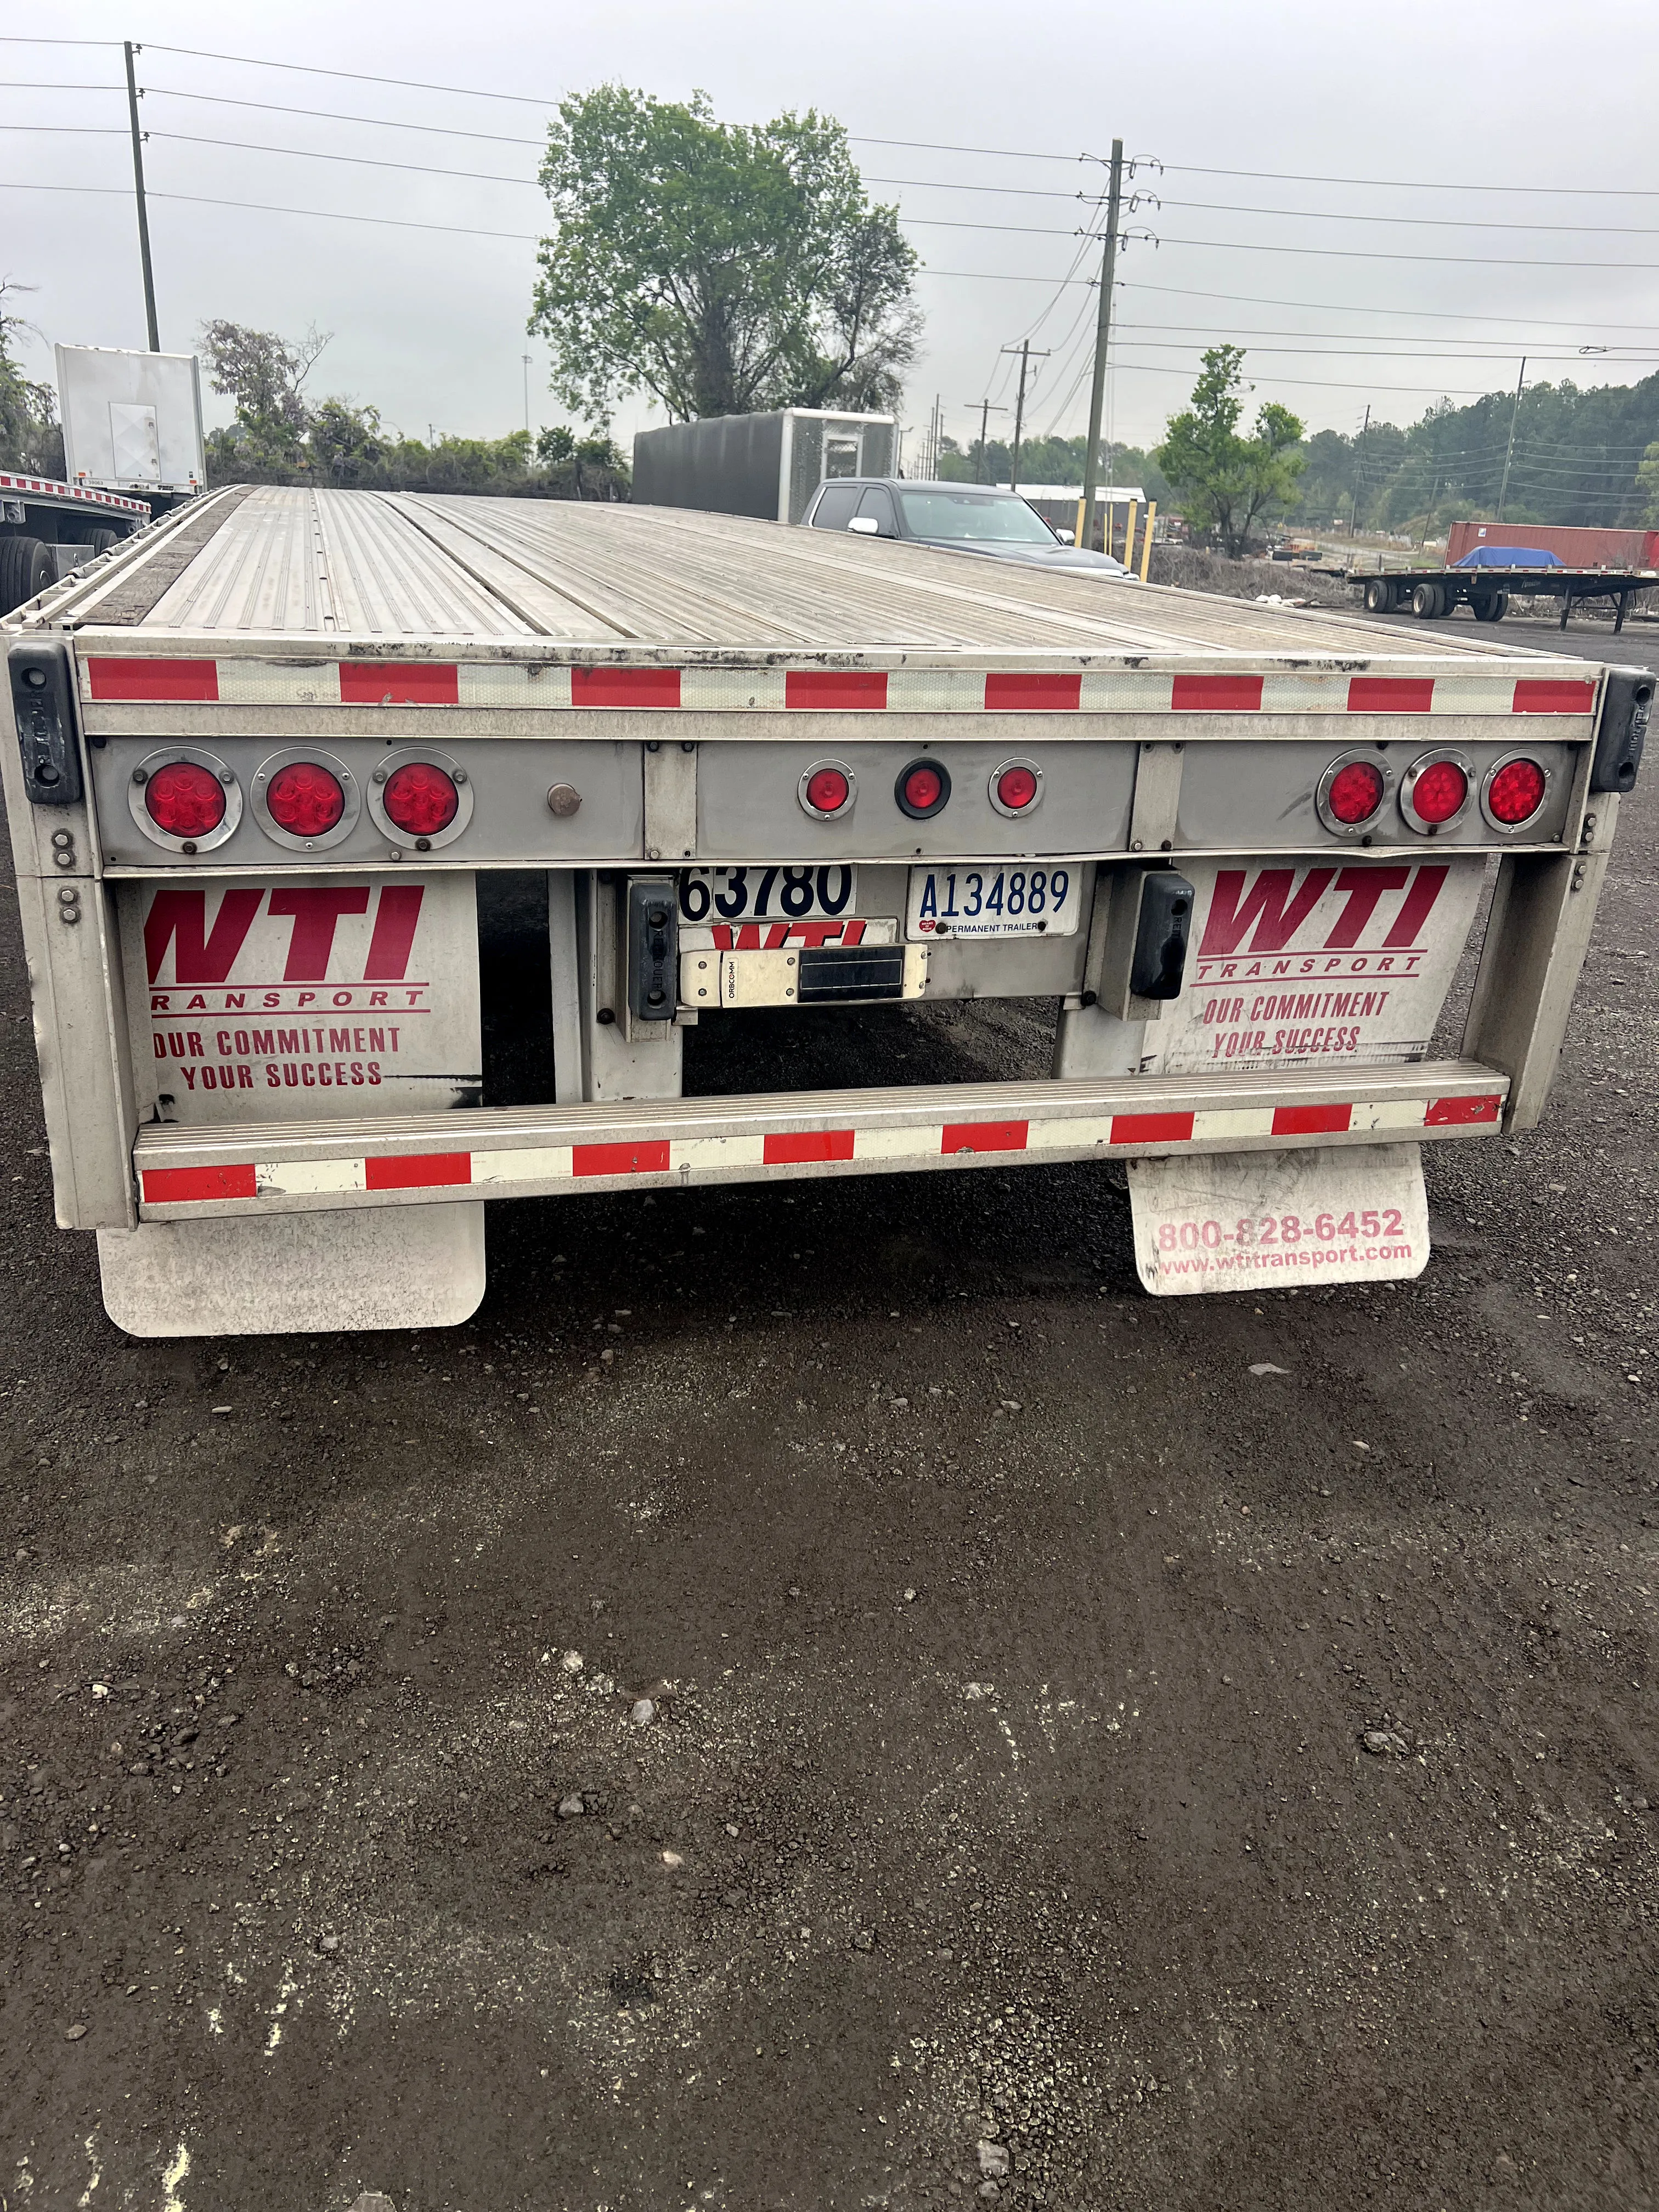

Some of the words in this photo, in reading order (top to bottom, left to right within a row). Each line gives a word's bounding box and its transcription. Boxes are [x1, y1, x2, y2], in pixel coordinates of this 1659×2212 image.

[679, 865, 852, 922] 63780
[919, 871, 1069, 918] A134889
[1198, 865, 1450, 956] WTI
[946, 924, 1000, 933] PERMANENT
[1003, 923, 1037, 932] TRAILER
[1198, 957, 1421, 980] TRANSPORT
[150, 990, 424, 1011] RANSPORT
[1203, 998, 1243, 1024] OUR
[1250, 991, 1390, 1022] COMMITMENT
[153, 1031, 205, 1059] OUR
[217, 1027, 400, 1056] COMMITMENT
[1211, 1030, 1266, 1058] YOUR
[1272, 1026, 1361, 1054] SUCCESS
[180, 1063, 253, 1090] YOUR
[267, 1061, 382, 1088] SUCCESS
[1158, 1209, 1404, 1252] 800-828-6452
[1159, 1242, 1412, 1275] www.wtitransport.com
